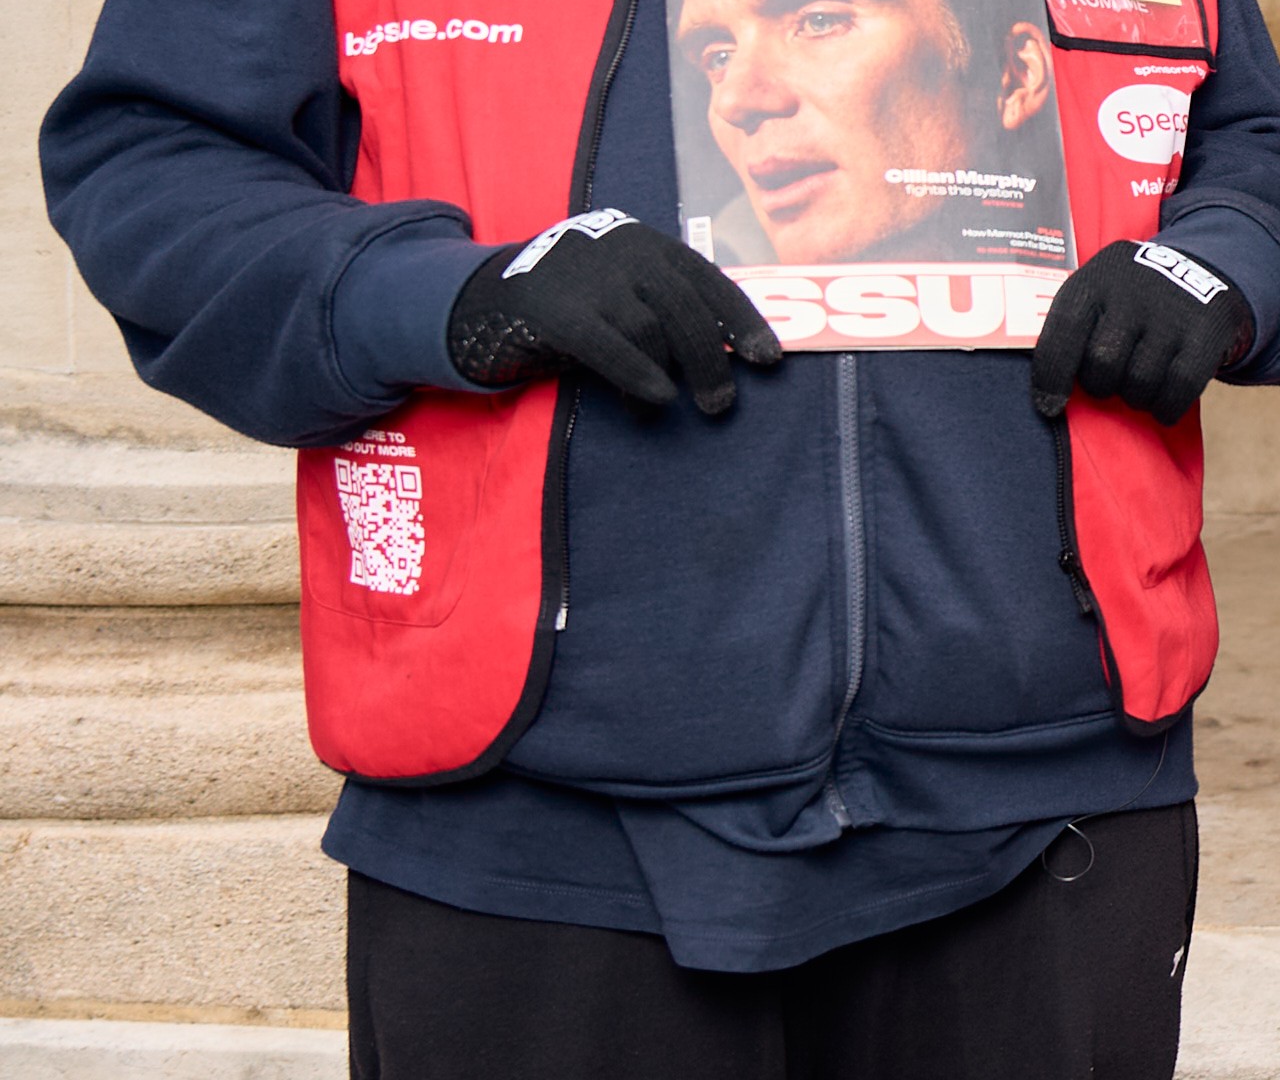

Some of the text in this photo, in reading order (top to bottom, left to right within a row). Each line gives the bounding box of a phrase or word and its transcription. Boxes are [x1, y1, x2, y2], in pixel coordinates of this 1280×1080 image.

[1134, 65, 1196, 77] sponsored
[884, 168, 1036, 192] Cillian Murphy
[905, 183, 1024, 200] fights the system
[387, 432, 406, 444] TO
[354, 442, 377, 455] OUT
[377, 445, 416, 458] MORE
